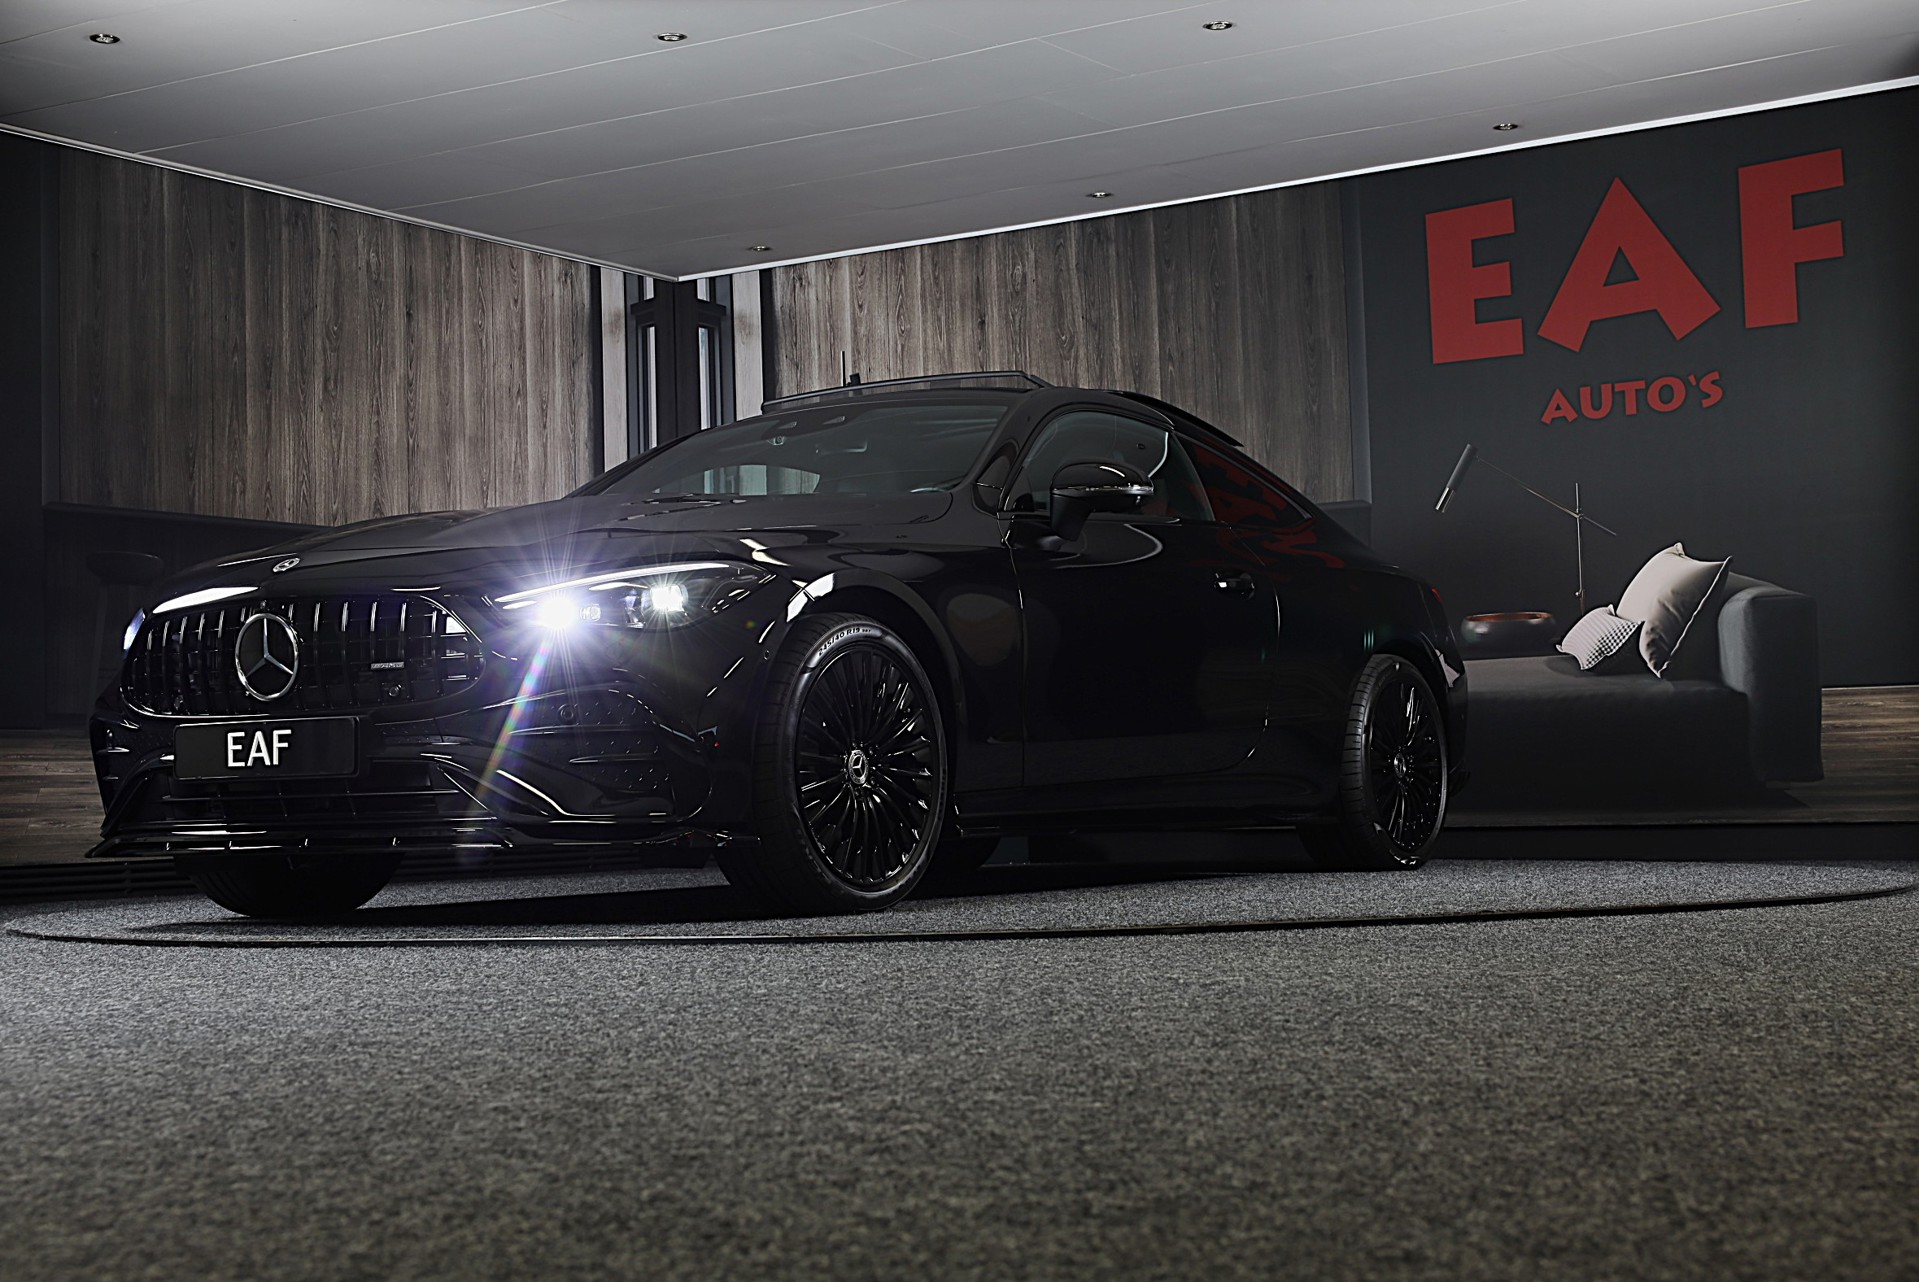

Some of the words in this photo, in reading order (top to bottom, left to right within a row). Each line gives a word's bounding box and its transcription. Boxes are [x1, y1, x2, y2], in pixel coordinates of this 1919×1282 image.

[1425, 148, 1844, 364] EAF
[1541, 371, 1725, 425] AUTO'S
[227, 729, 292, 767] EAF
